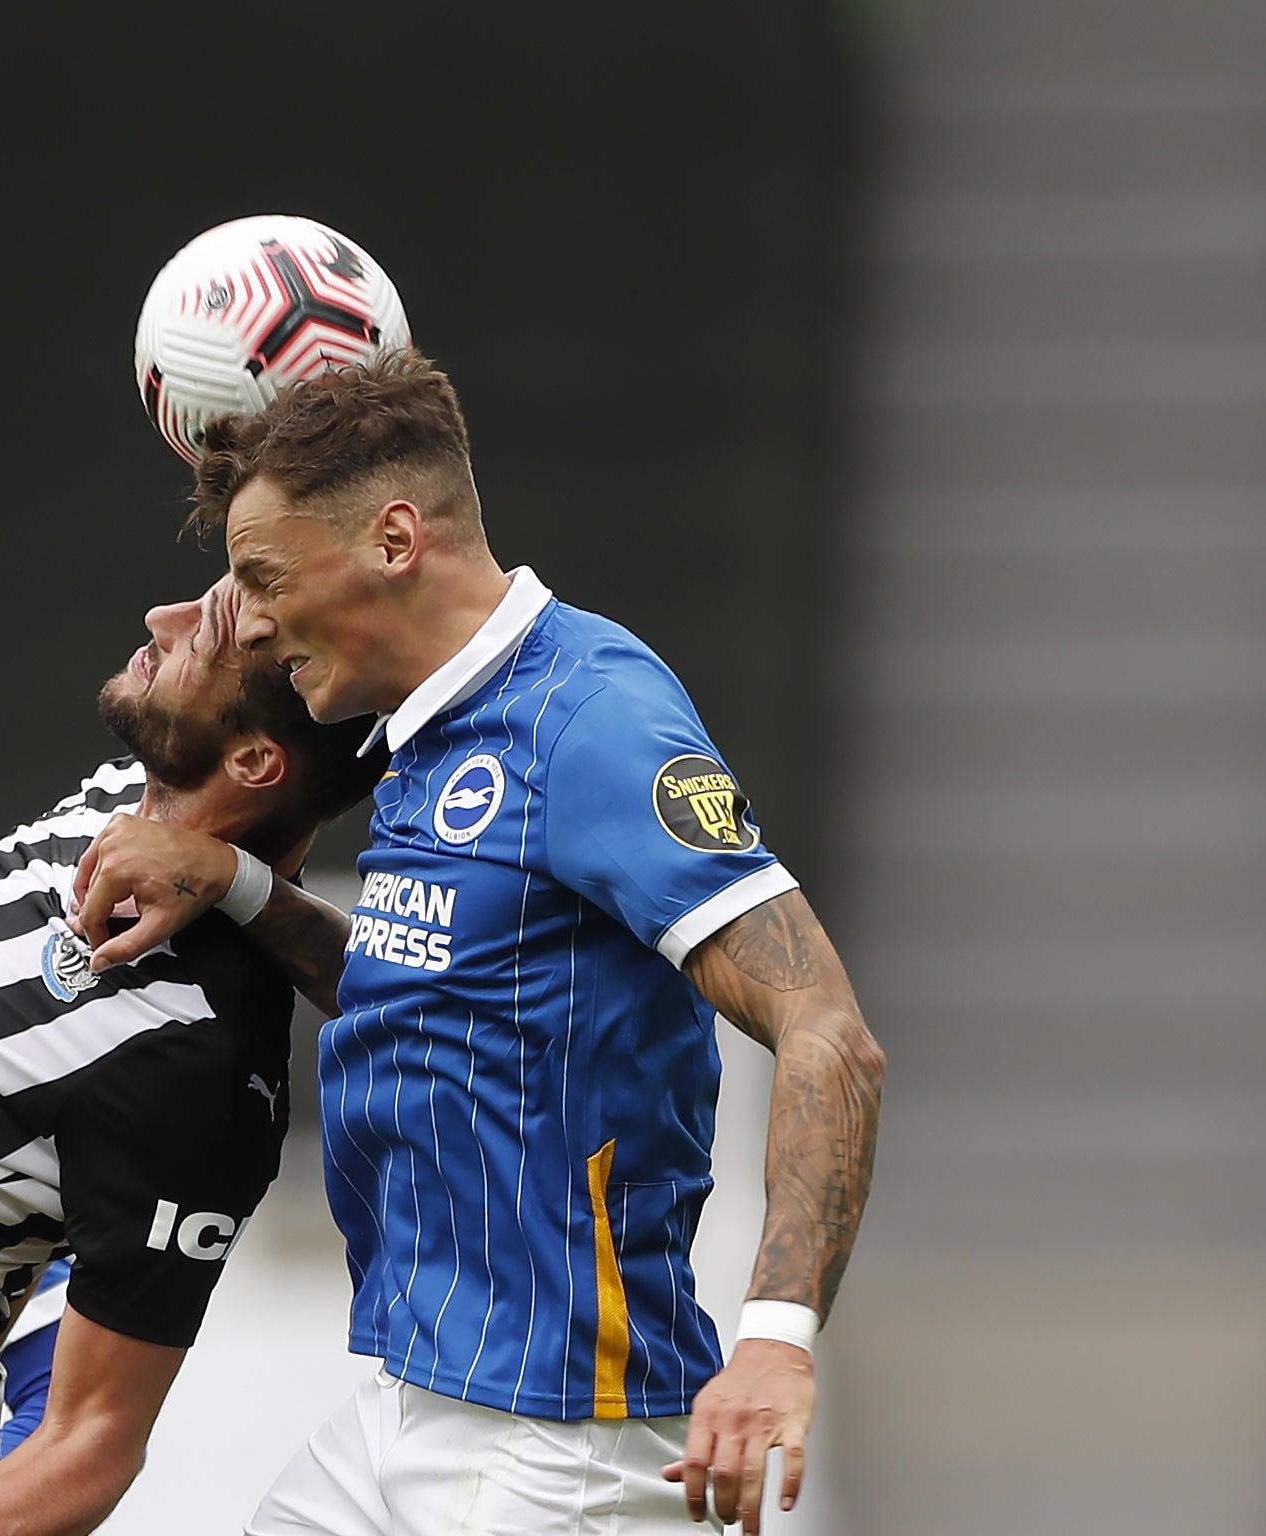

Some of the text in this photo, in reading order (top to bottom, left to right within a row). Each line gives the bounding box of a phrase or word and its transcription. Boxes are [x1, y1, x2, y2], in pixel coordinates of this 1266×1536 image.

[661, 773, 736, 799] SNICKERS
[444, 830, 471, 841] ALBION
[344, 913, 453, 973] XPRESS
[146, 1198, 252, 1261] IC
